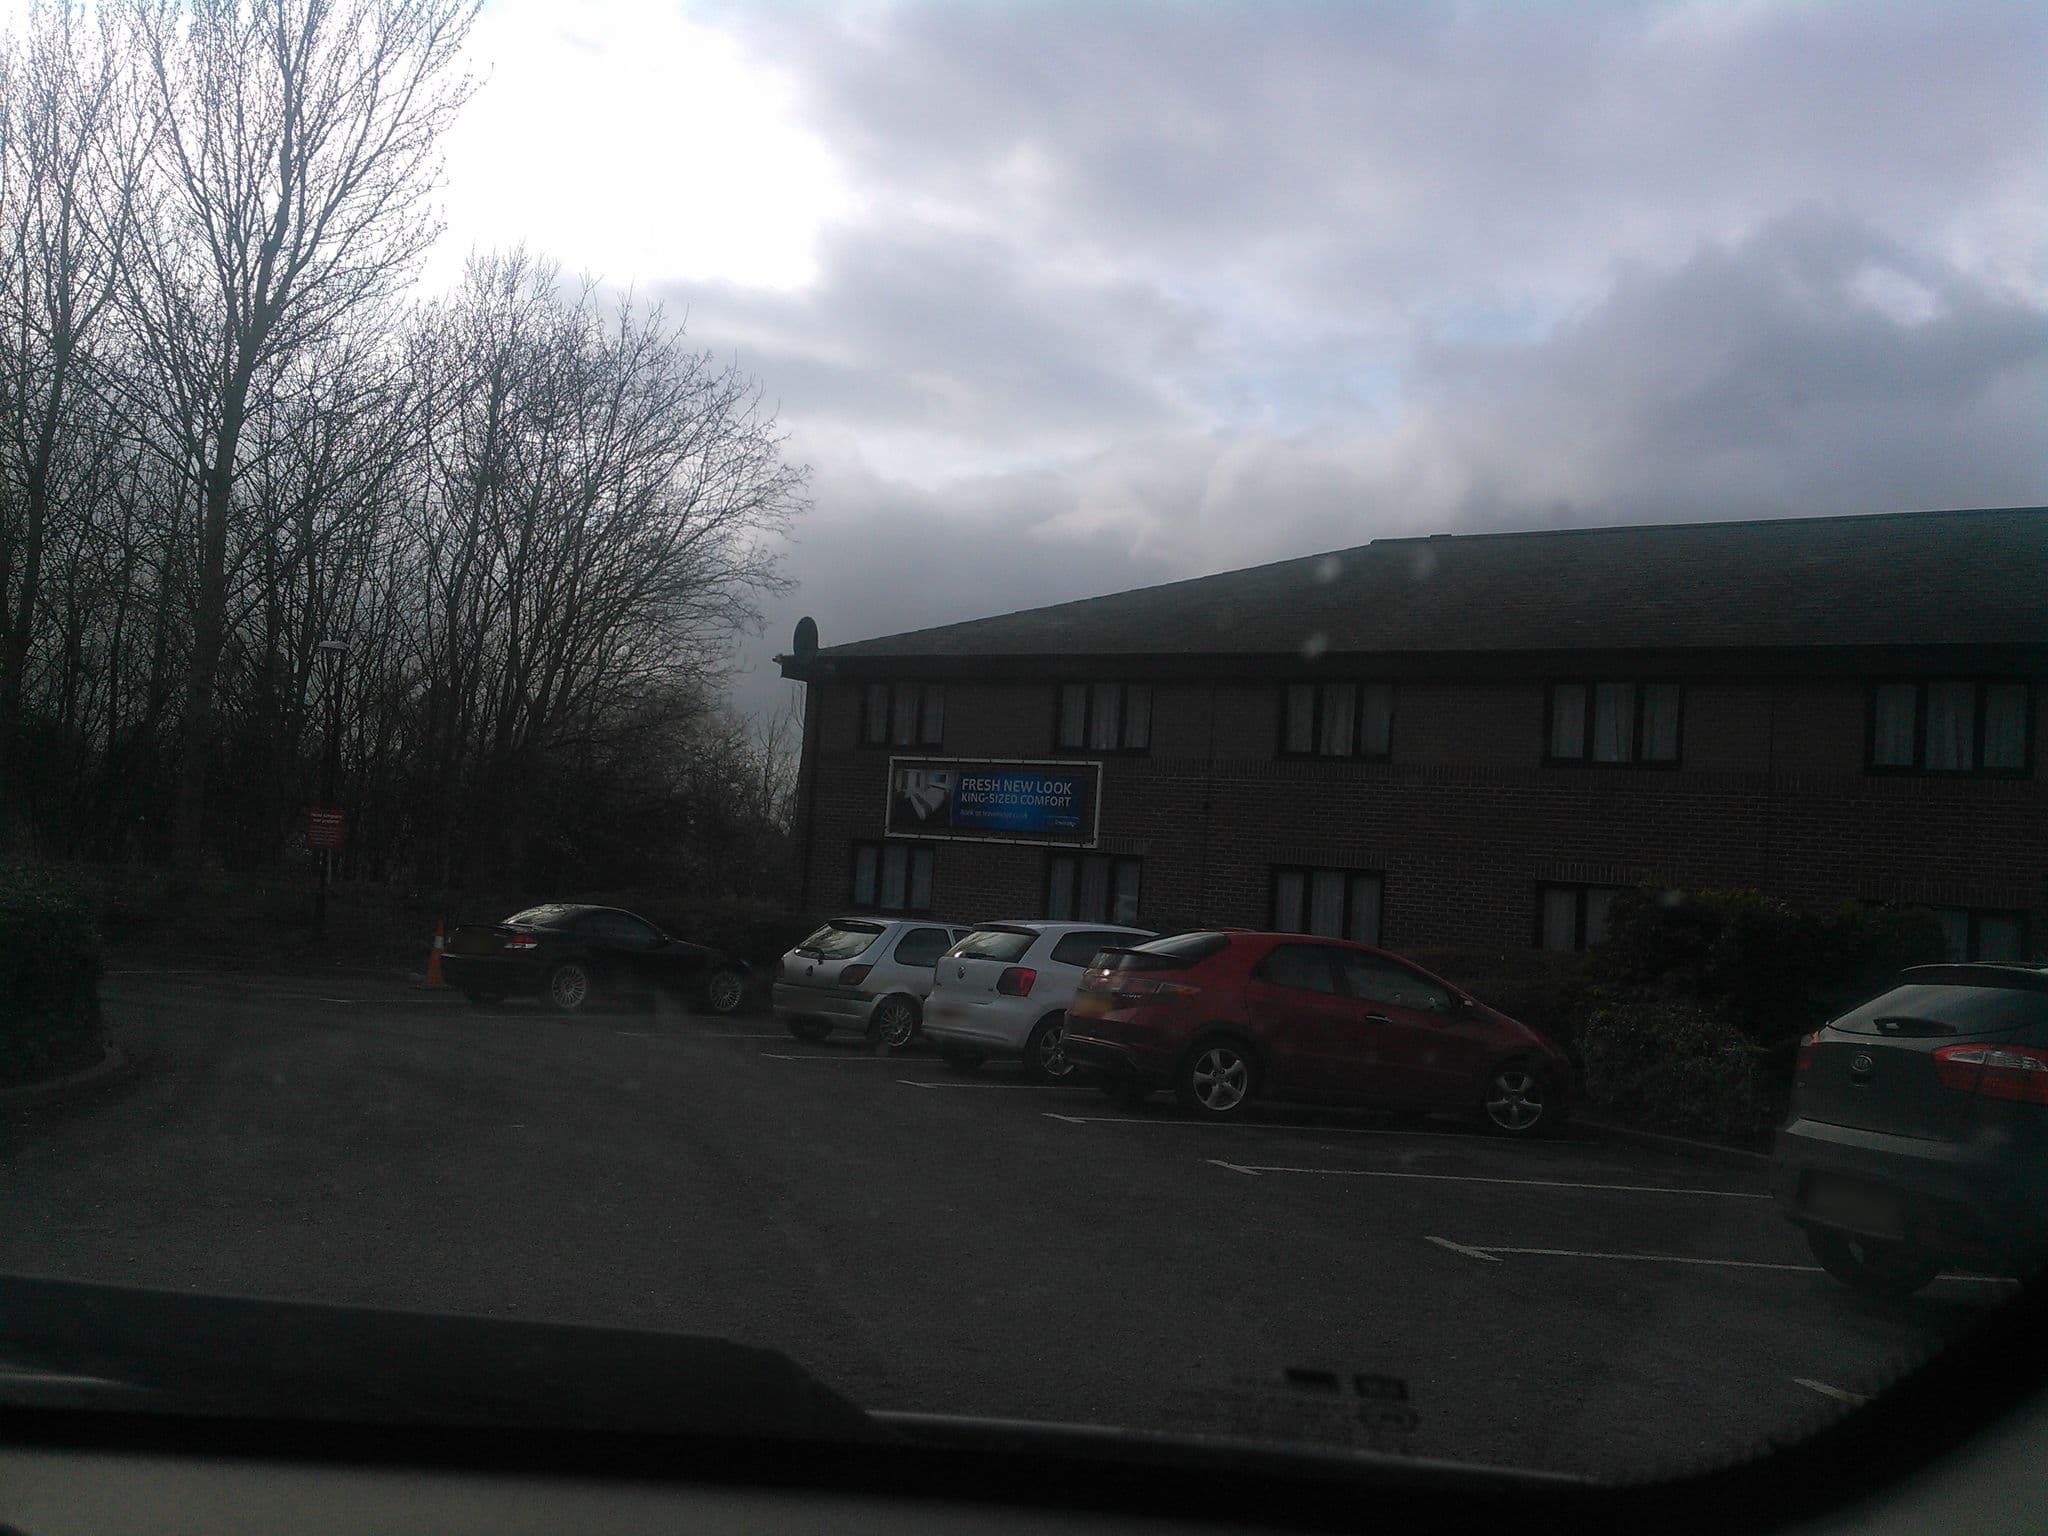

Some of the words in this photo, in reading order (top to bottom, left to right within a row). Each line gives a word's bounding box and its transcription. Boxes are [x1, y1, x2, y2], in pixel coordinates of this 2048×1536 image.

[961, 778, 1001, 791] FRESH
[1003, 779, 1034, 793] NEW
[1036, 781, 1072, 795] LOOK
[961, 793, 1018, 804] KING-SIZED
[1020, 795, 1072, 807] COMFORT
